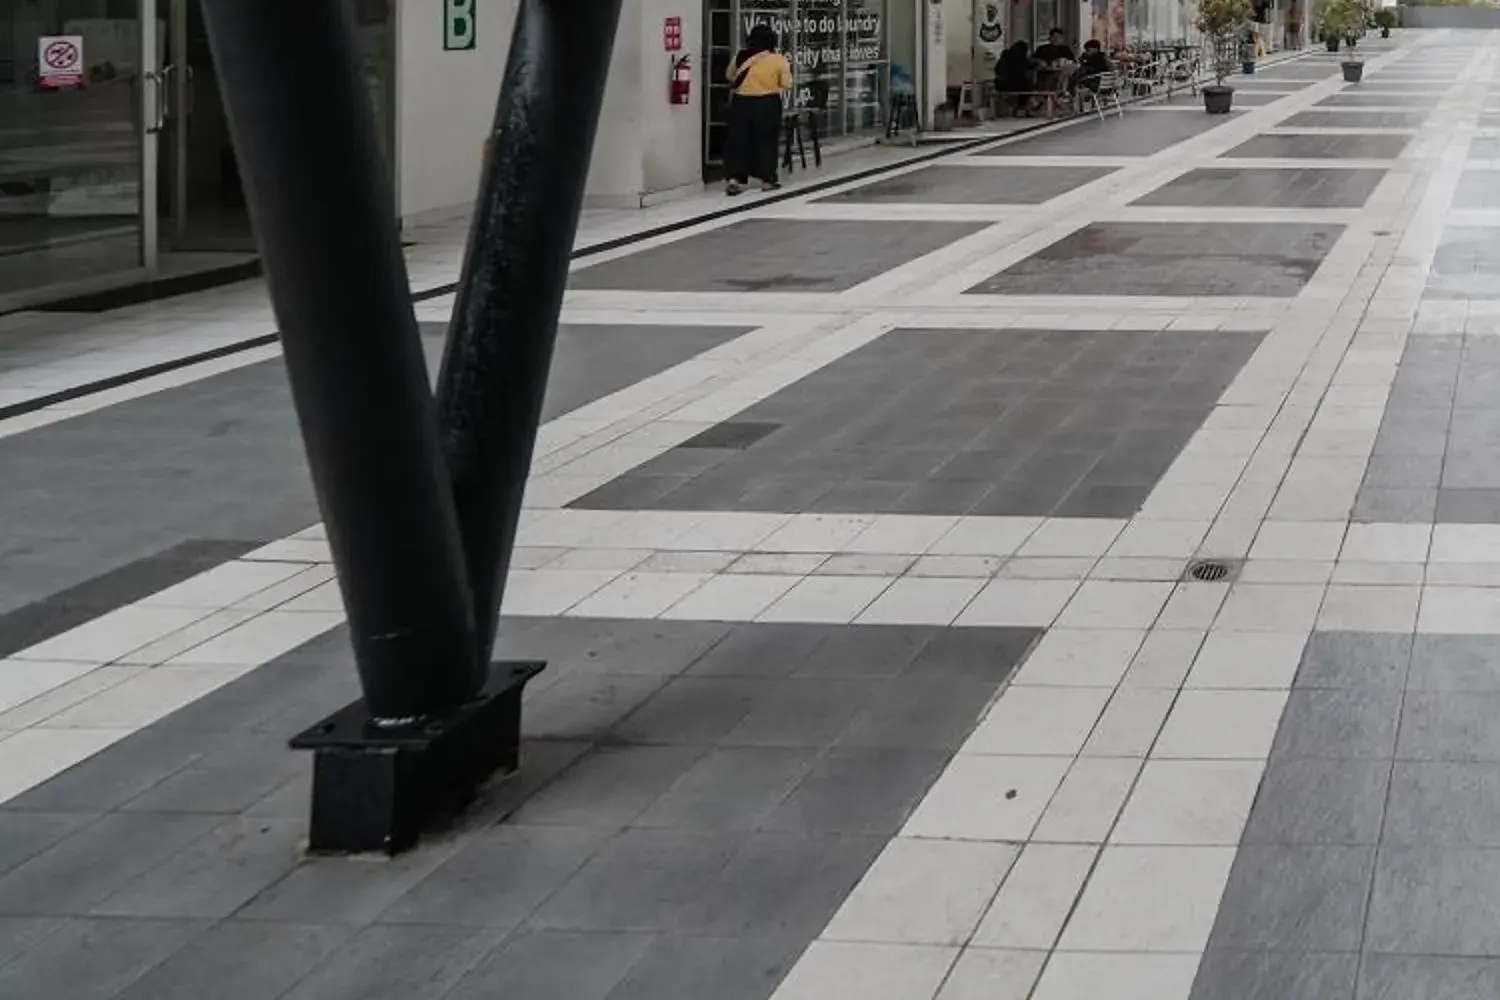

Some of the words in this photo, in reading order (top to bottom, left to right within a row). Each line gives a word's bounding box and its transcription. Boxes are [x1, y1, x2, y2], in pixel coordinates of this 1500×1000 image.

[803, 18, 817, 33] to
[819, 16, 835, 33] do
[795, 46, 820, 68] city
